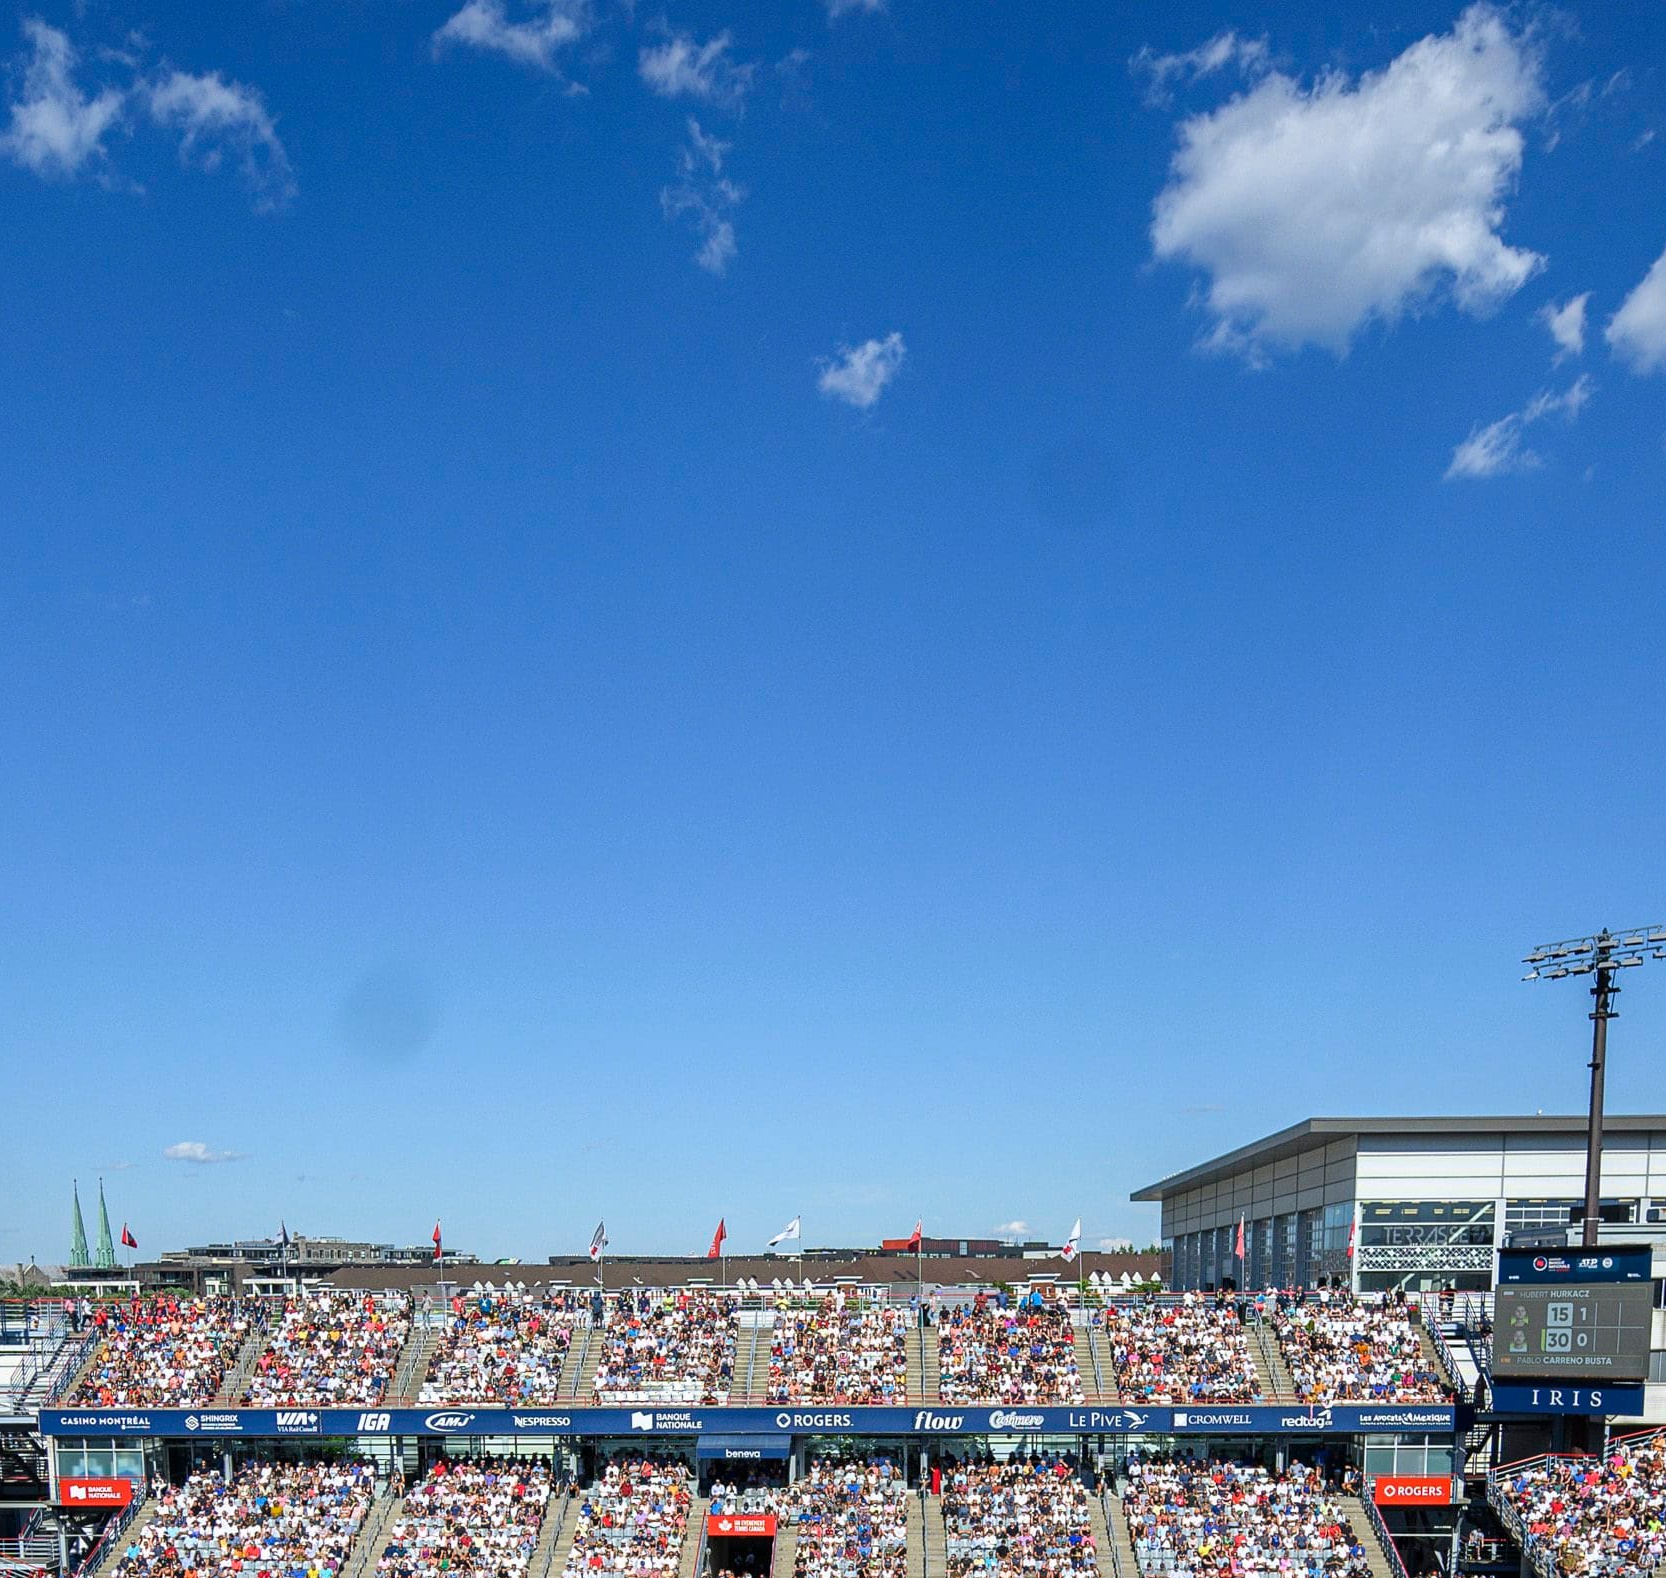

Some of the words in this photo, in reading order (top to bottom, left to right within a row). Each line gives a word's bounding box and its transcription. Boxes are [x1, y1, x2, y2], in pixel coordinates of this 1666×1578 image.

[1520, 1290, 1549, 1298] HUBERT
[1550, 1290, 1590, 1298] HURKACZ
[1551, 1307, 1569, 1321] 15
[1579, 1307, 1587, 1321] 1
[1547, 1333, 1569, 1347] 30
[1577, 1333, 1588, 1347] 0
[1517, 1357, 1541, 1365] PABLO
[1543, 1356, 1583, 1365] CARRENO
[1584, 1357, 1612, 1366] BUSTA
[1532, 1389, 1602, 1407] IRIS
[60, 1417, 97, 1425] CASINO
[99, 1415, 151, 1425] MONTRÉAL
[200, 1414, 238, 1423] SHINGRIX
[276, 1412, 307, 1426] VIA
[357, 1413, 391, 1431] IGA
[513, 1415, 571, 1427] NESPRESSO
[656, 1412, 692, 1422] BANQUE
[793, 1412, 852, 1427] ROGERS
[913, 1410, 965, 1431] flow
[989, 1410, 1044, 1429] Cashmere
[1188, 1414, 1252, 1425] CROMWELL
[656, 1421, 702, 1430] NATIONALE
[725, 1448, 761, 1459] beneva
[1397, 1485, 1442, 1497] ROGERS
